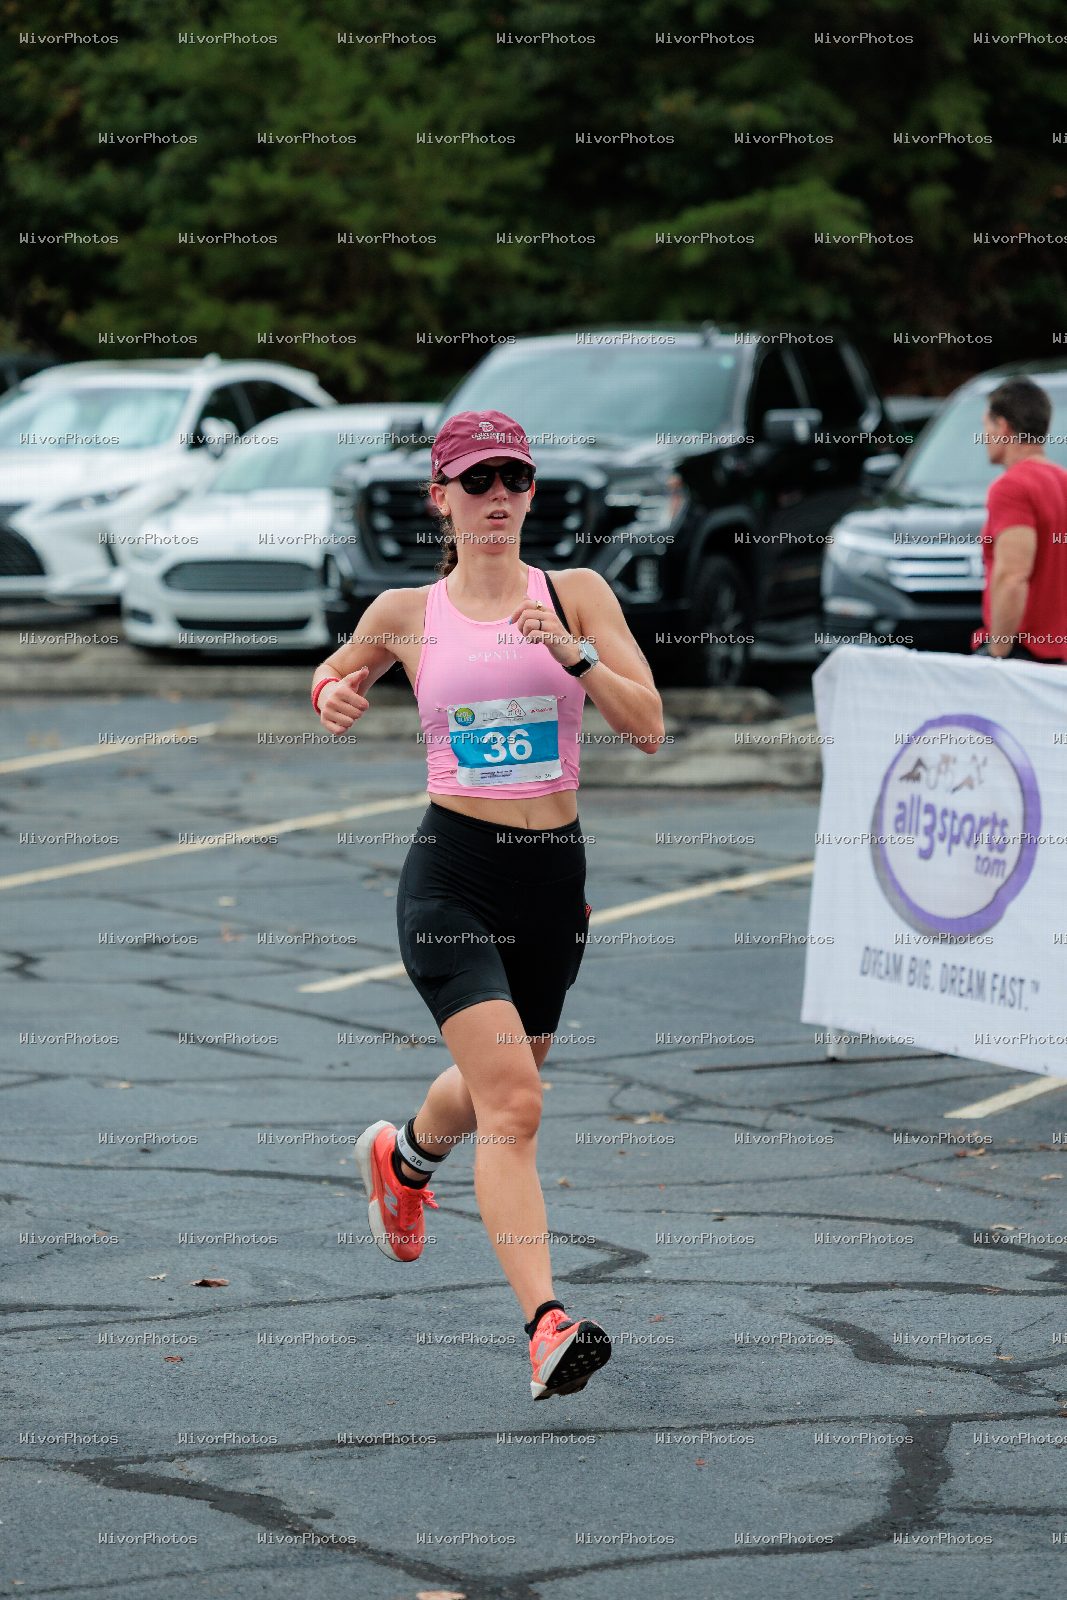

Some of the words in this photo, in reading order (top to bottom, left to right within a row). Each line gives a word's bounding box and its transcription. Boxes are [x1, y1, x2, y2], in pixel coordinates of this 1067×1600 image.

[483, 728, 533, 764] 36
[939, 962, 986, 1002] DREAM
[410, 1155, 423, 1167] 36
